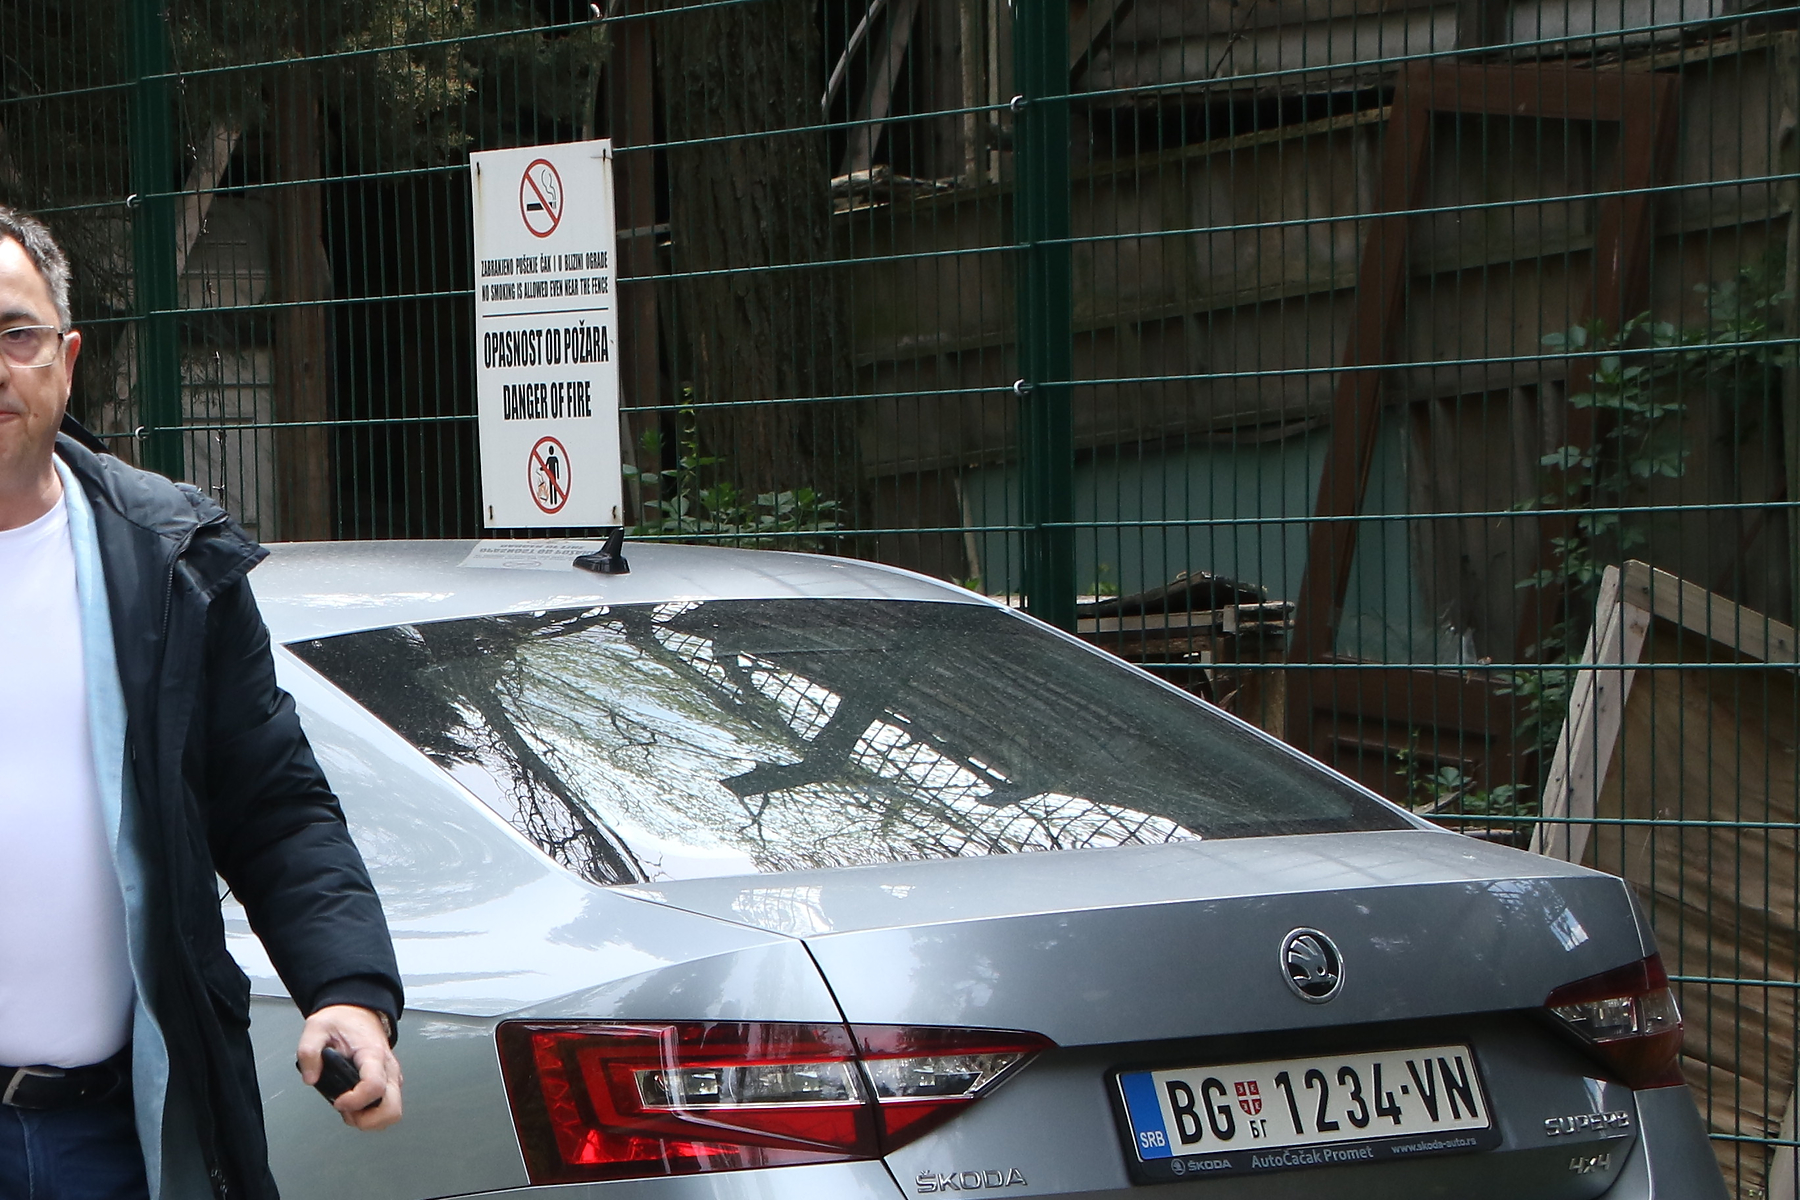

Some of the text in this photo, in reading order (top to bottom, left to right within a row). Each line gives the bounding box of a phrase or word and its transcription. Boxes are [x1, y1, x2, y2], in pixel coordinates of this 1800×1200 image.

[481, 258, 514, 278] ZABRANJENO
[540, 252, 552, 273] ČAK
[553, 255, 557, 272] I
[558, 254, 563, 272] U
[586, 251, 608, 269] OGRADE
[481, 276, 608, 302] NO SMOKING IS ALLOWED EVEN NEAR THE FENCE
[484, 319, 609, 369] OPASNOST OD POŽARA
[503, 380, 592, 420] DANGER OF FIRE
[1165, 1077, 1236, 1146] BG
[1544, 1111, 1630, 1136] SUPERB
[1139, 1131, 1166, 1149] SRB
[1188, 1138, 1477, 1171] ŠKODA AutoČačak Promet www.skoda-auto.rs
[915, 1168, 1028, 1193] ŠKODA
